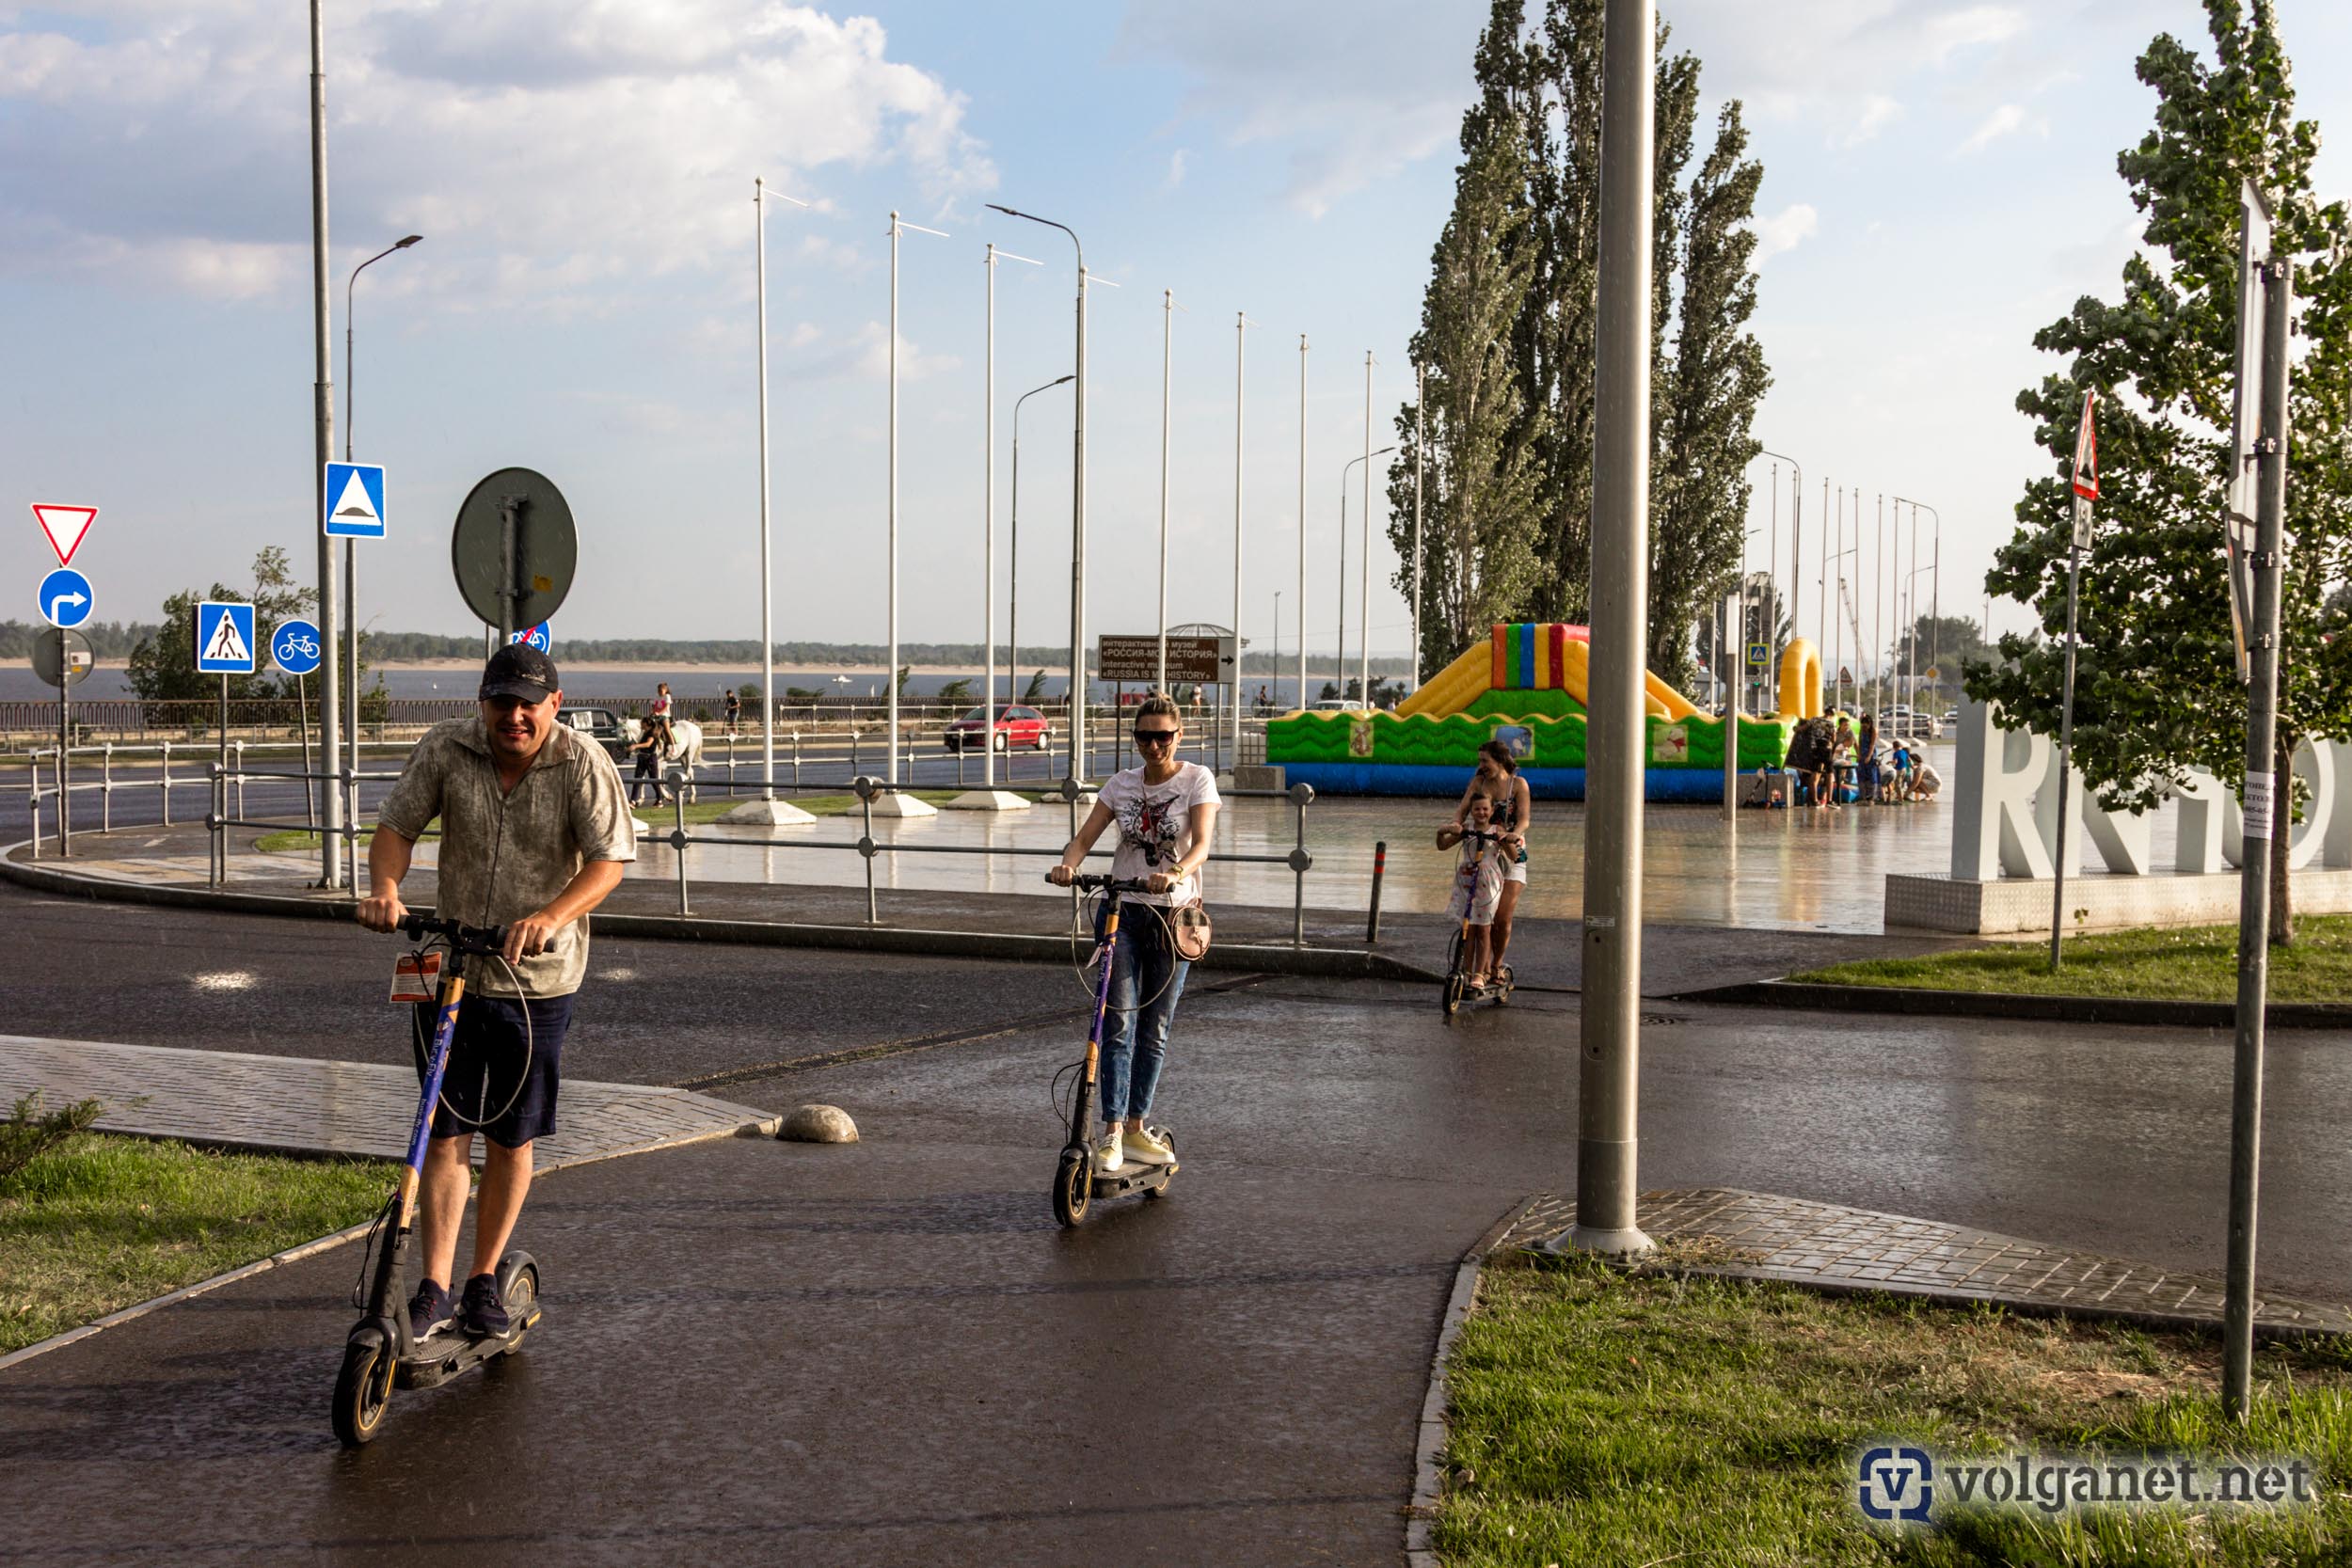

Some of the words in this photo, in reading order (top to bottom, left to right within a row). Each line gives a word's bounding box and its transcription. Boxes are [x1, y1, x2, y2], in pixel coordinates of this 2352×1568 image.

[1103, 640, 1168, 649] интерактивнй
[1171, 641, 1198, 651] музей
[1103, 649, 1167, 658] «РОССИЯ-МО
[1169, 650, 1217, 658] ИСТОРИЯ»
[1102, 659, 1146, 669] interactive
[1148, 661, 1184, 670] mueum
[1103, 669, 1140, 678] «RUSSIA
[1141, 670, 1150, 678] IS
[1167, 671, 1211, 680] HISTORY»
